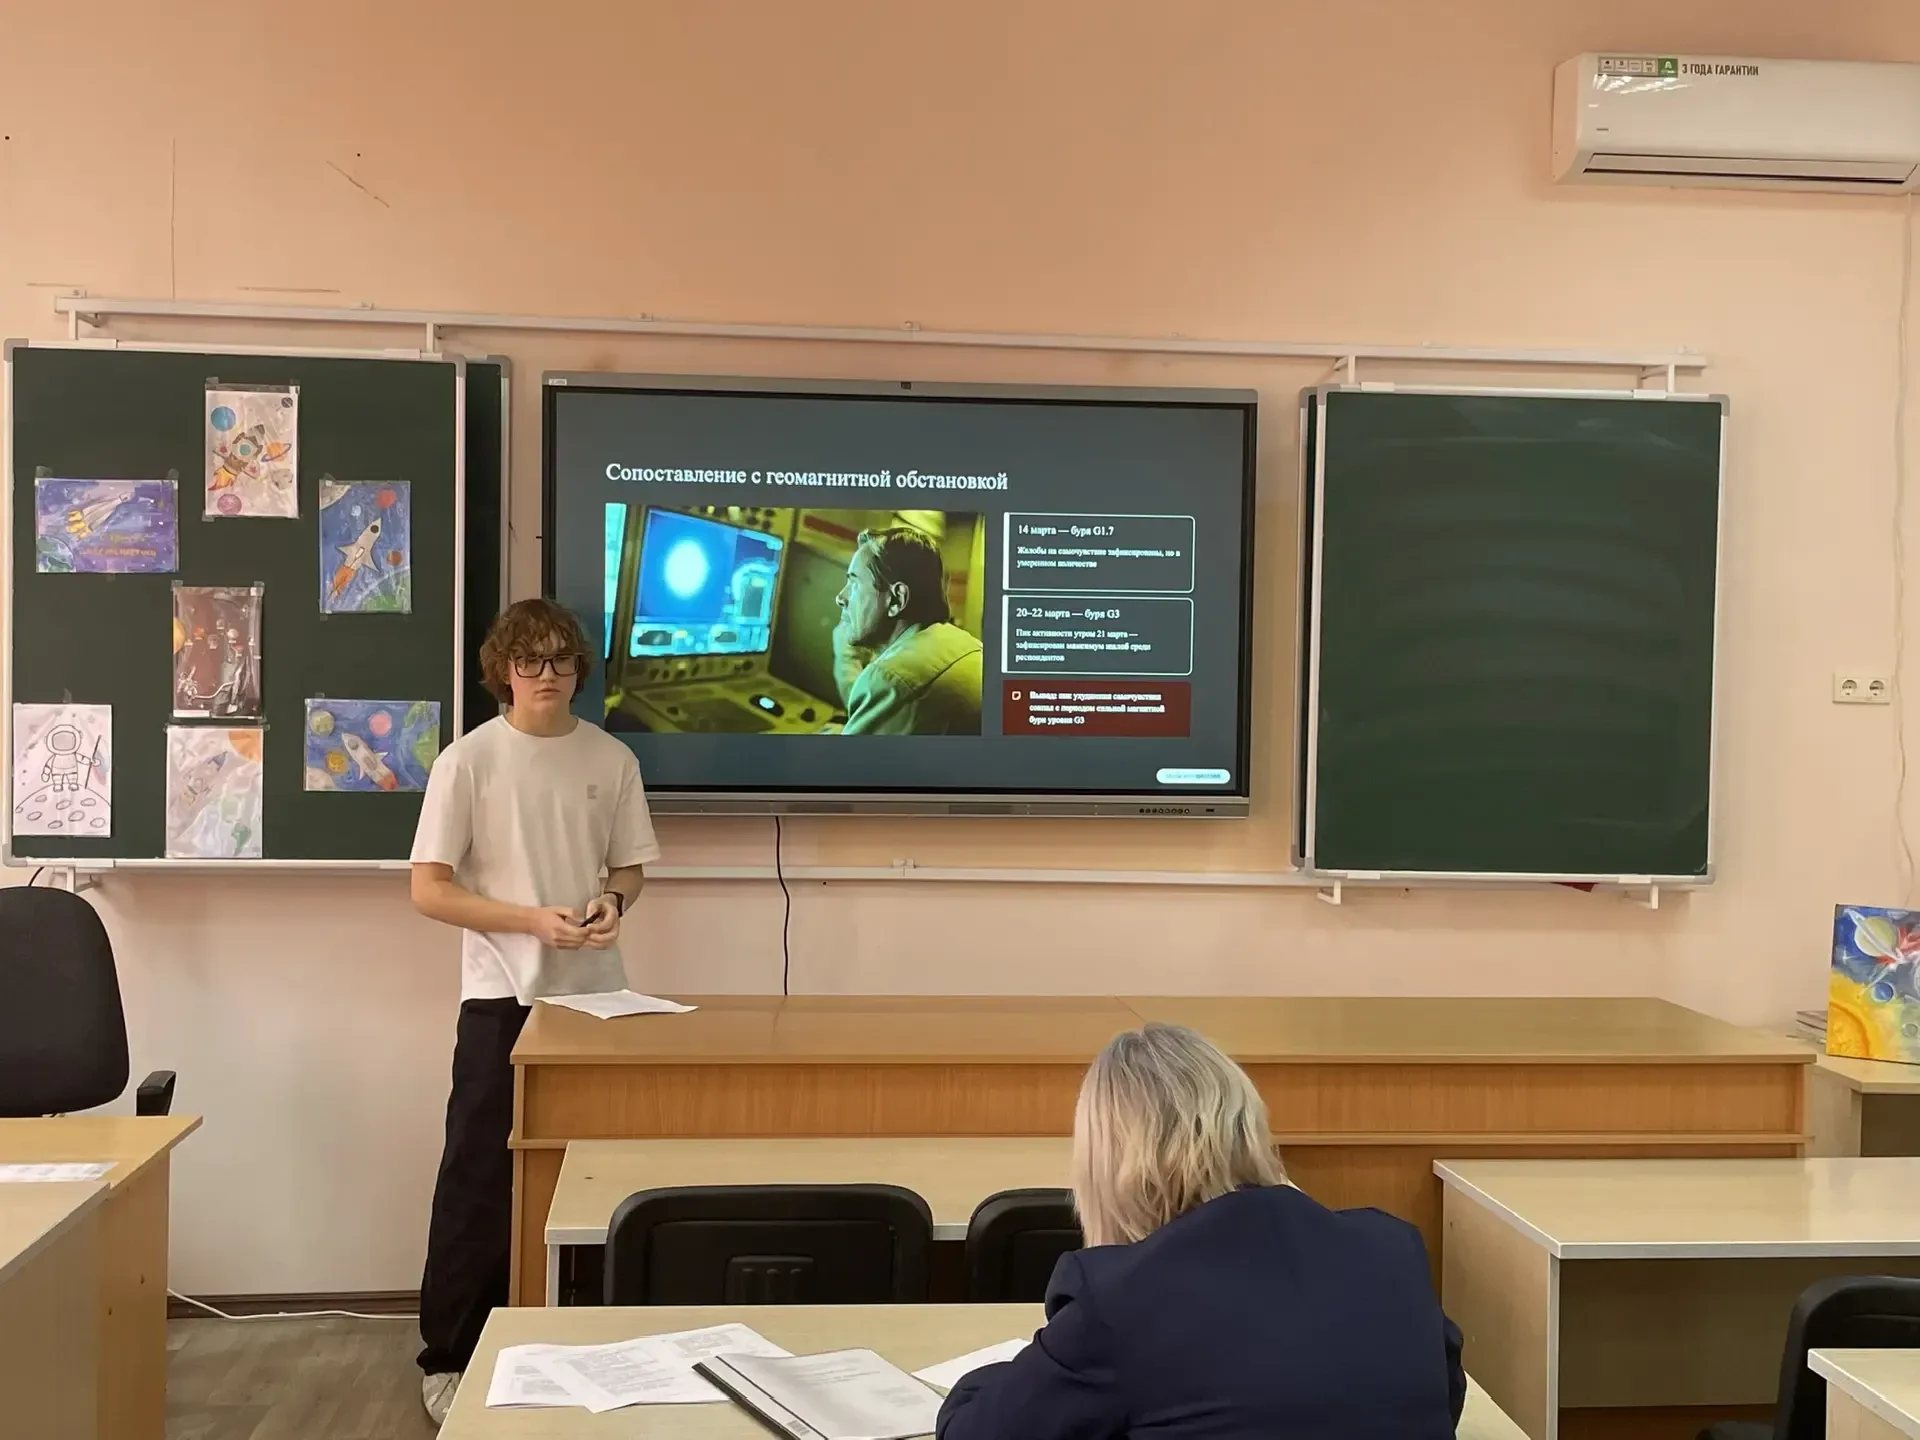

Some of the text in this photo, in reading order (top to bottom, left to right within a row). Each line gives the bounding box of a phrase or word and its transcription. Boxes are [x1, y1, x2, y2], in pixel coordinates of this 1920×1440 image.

[1682, 63, 1688, 74] 3
[1690, 63, 1713, 76] ГОДА
[1715, 64, 1759, 76] ГАРАНТИИ
[605, 463, 1009, 491] Сопоставление с геомагнитной обстановкой
[1018, 525, 1029, 535] 14
[1030, 526, 1057, 537] марта
[1070, 525, 1092, 538] буря
[1093, 526, 1115, 536] G1.7
[1017, 546, 1047, 555] Жалобы
[1058, 549, 1107, 558] самочувствие
[1057, 560, 1098, 569] количестве
[1044, 609, 1071, 620] марта
[1084, 608, 1105, 621] буря
[1107, 609, 1121, 619] G3
[1015, 628, 1031, 637] Пик
[1032, 630, 1072, 638] активности
[1073, 631, 1096, 640] утром
[1097, 630, 1106, 638] 21
[1107, 631, 1128, 640] марта
[1066, 643, 1105, 652] максимум
[1105, 642, 1130, 650] жалоб
[1130, 643, 1151, 652] среди
[1015, 653, 1065, 662] респондентов
[1028, 715, 1047, 726] бури
[1074, 715, 1085, 724] G3
